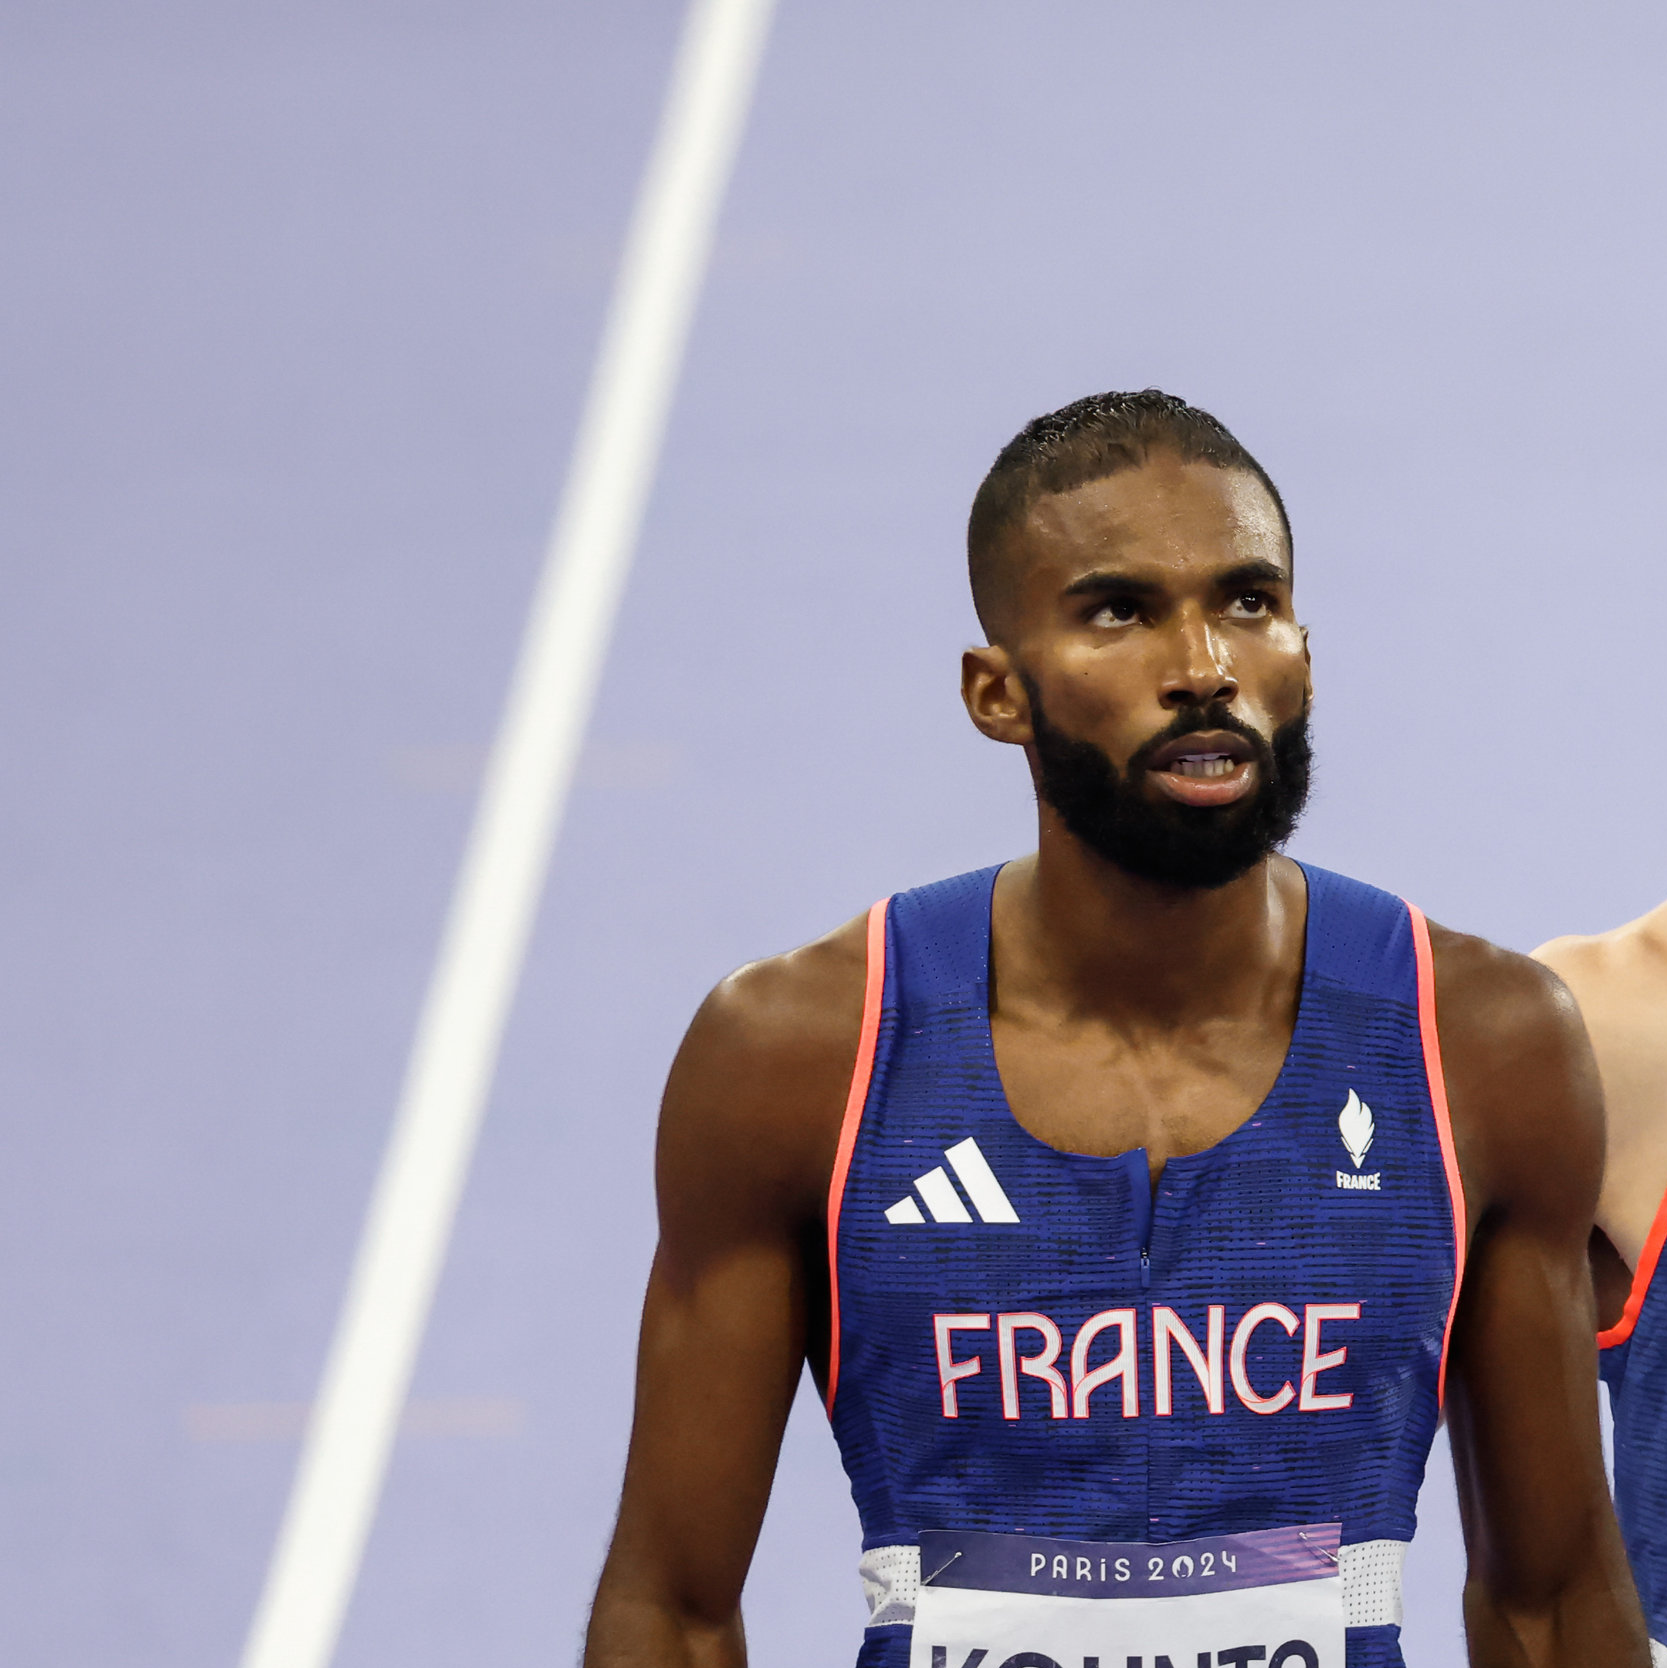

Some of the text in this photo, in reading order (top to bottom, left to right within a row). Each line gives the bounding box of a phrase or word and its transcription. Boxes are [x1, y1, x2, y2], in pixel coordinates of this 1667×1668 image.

[1336, 1170, 1381, 1191] FRANCE
[932, 1302, 1363, 1419] FRANCE
[1148, 1550, 1237, 1581] 2024
